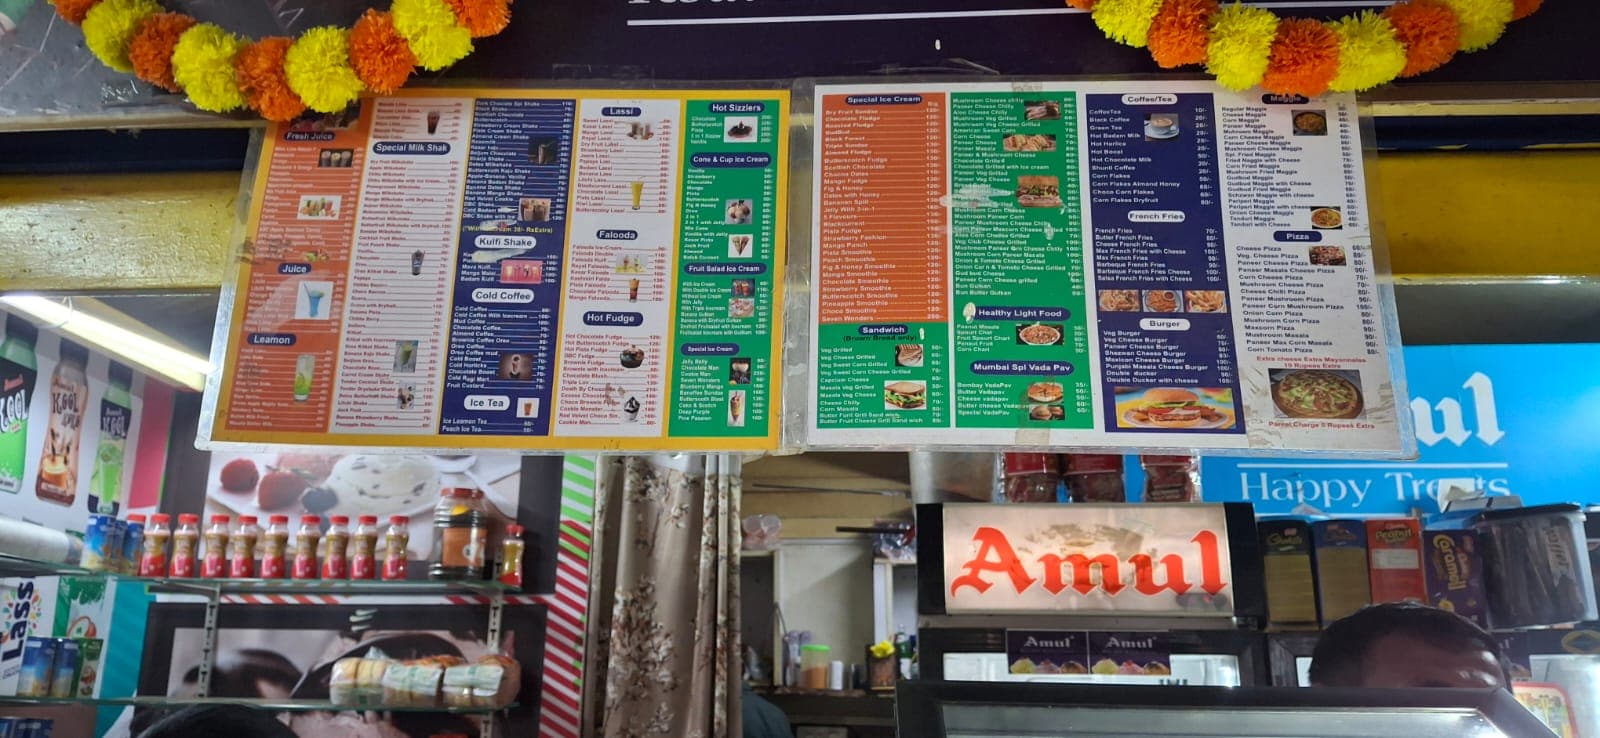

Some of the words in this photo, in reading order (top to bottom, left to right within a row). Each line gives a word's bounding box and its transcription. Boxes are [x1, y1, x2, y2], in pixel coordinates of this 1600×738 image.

[377, 144, 406, 152] Special
[599, 231, 635, 239] Falooda
[480, 238, 502, 246] Kulfi
[505, 238, 532, 246] Shake
[475, 291, 497, 300] Cold
[500, 292, 530, 300] Coffee
[606, 314, 634, 323] Fudge
[254, 335, 290, 344] Leamon
[470, 399, 485, 407] Ice
[1409, 372, 1505, 447] ul
[1240, 472, 1372, 508] Happy
[1384, 472, 1511, 500] Trets
[951, 526, 1228, 598] Amul
[1024, 636, 1071, 648] Amul
[1106, 637, 1154, 649] Amul
